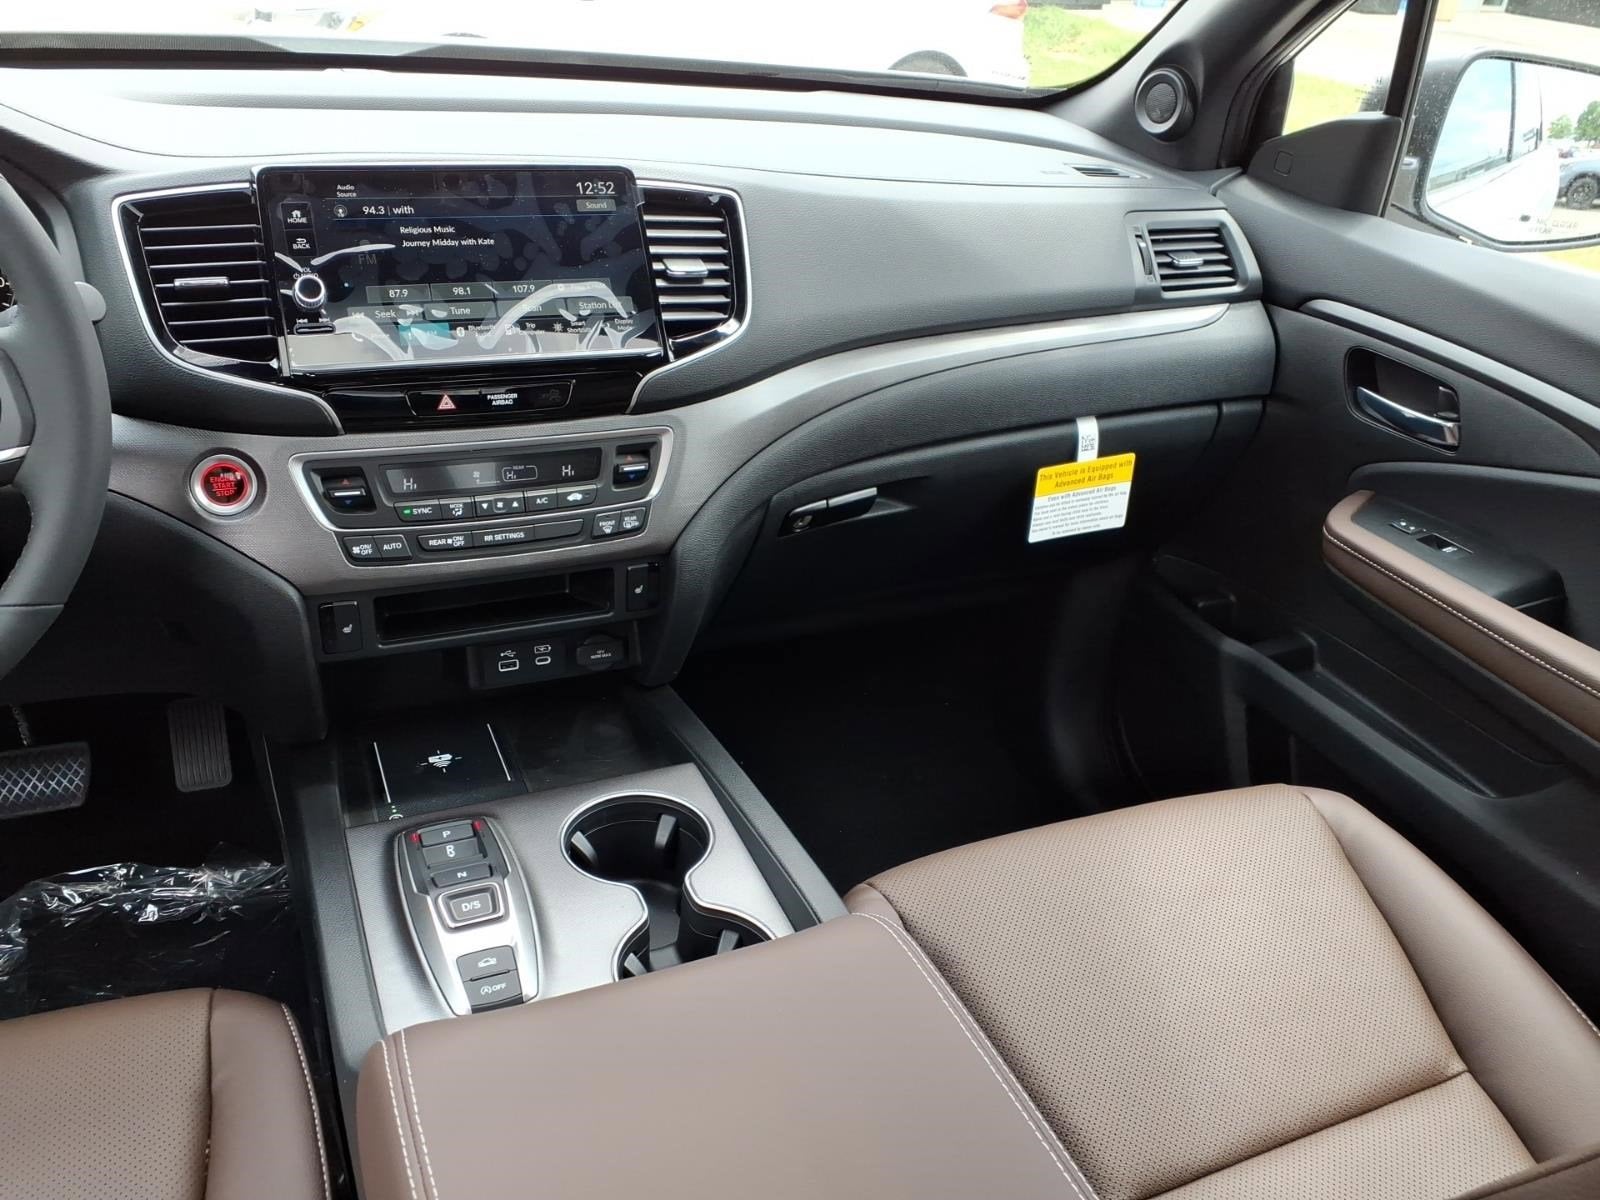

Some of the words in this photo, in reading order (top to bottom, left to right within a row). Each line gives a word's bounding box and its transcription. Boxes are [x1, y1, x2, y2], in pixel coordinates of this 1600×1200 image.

[576, 182, 616, 195] 12:52
[362, 206, 385, 215] 94.3
[392, 205, 415, 214] with
[585, 201, 607, 209] Sound
[400, 226, 432, 234] Religious
[433, 226, 456, 234] Music
[402, 240, 430, 248] Journey
[432, 239, 459, 247] Midday
[461, 238, 476, 246] with
[478, 237, 495, 246] Kate
[389, 289, 409, 298] 87.9
[452, 287, 471, 296] 98.1
[512, 284, 536, 294] 107.9
[375, 310, 397, 319] Seek
[449, 307, 471, 316] Tune
[578, 302, 607, 310] Station
[1040, 473, 1053, 481] This
[1055, 469, 1078, 479] Vehicle
[1087, 461, 1117, 474] Equipped
[1119, 460, 1133, 468] with
[1055, 477, 1085, 488] Advanced
[1087, 475, 1096, 483] Air
[1098, 472, 1114, 482] Bags
[494, 532, 524, 540] SETTINGS
[429, 538, 447, 546] REAR
[442, 830, 451, 838] P
[462, 901, 481, 912] D/S
[492, 983, 507, 991] OFF
